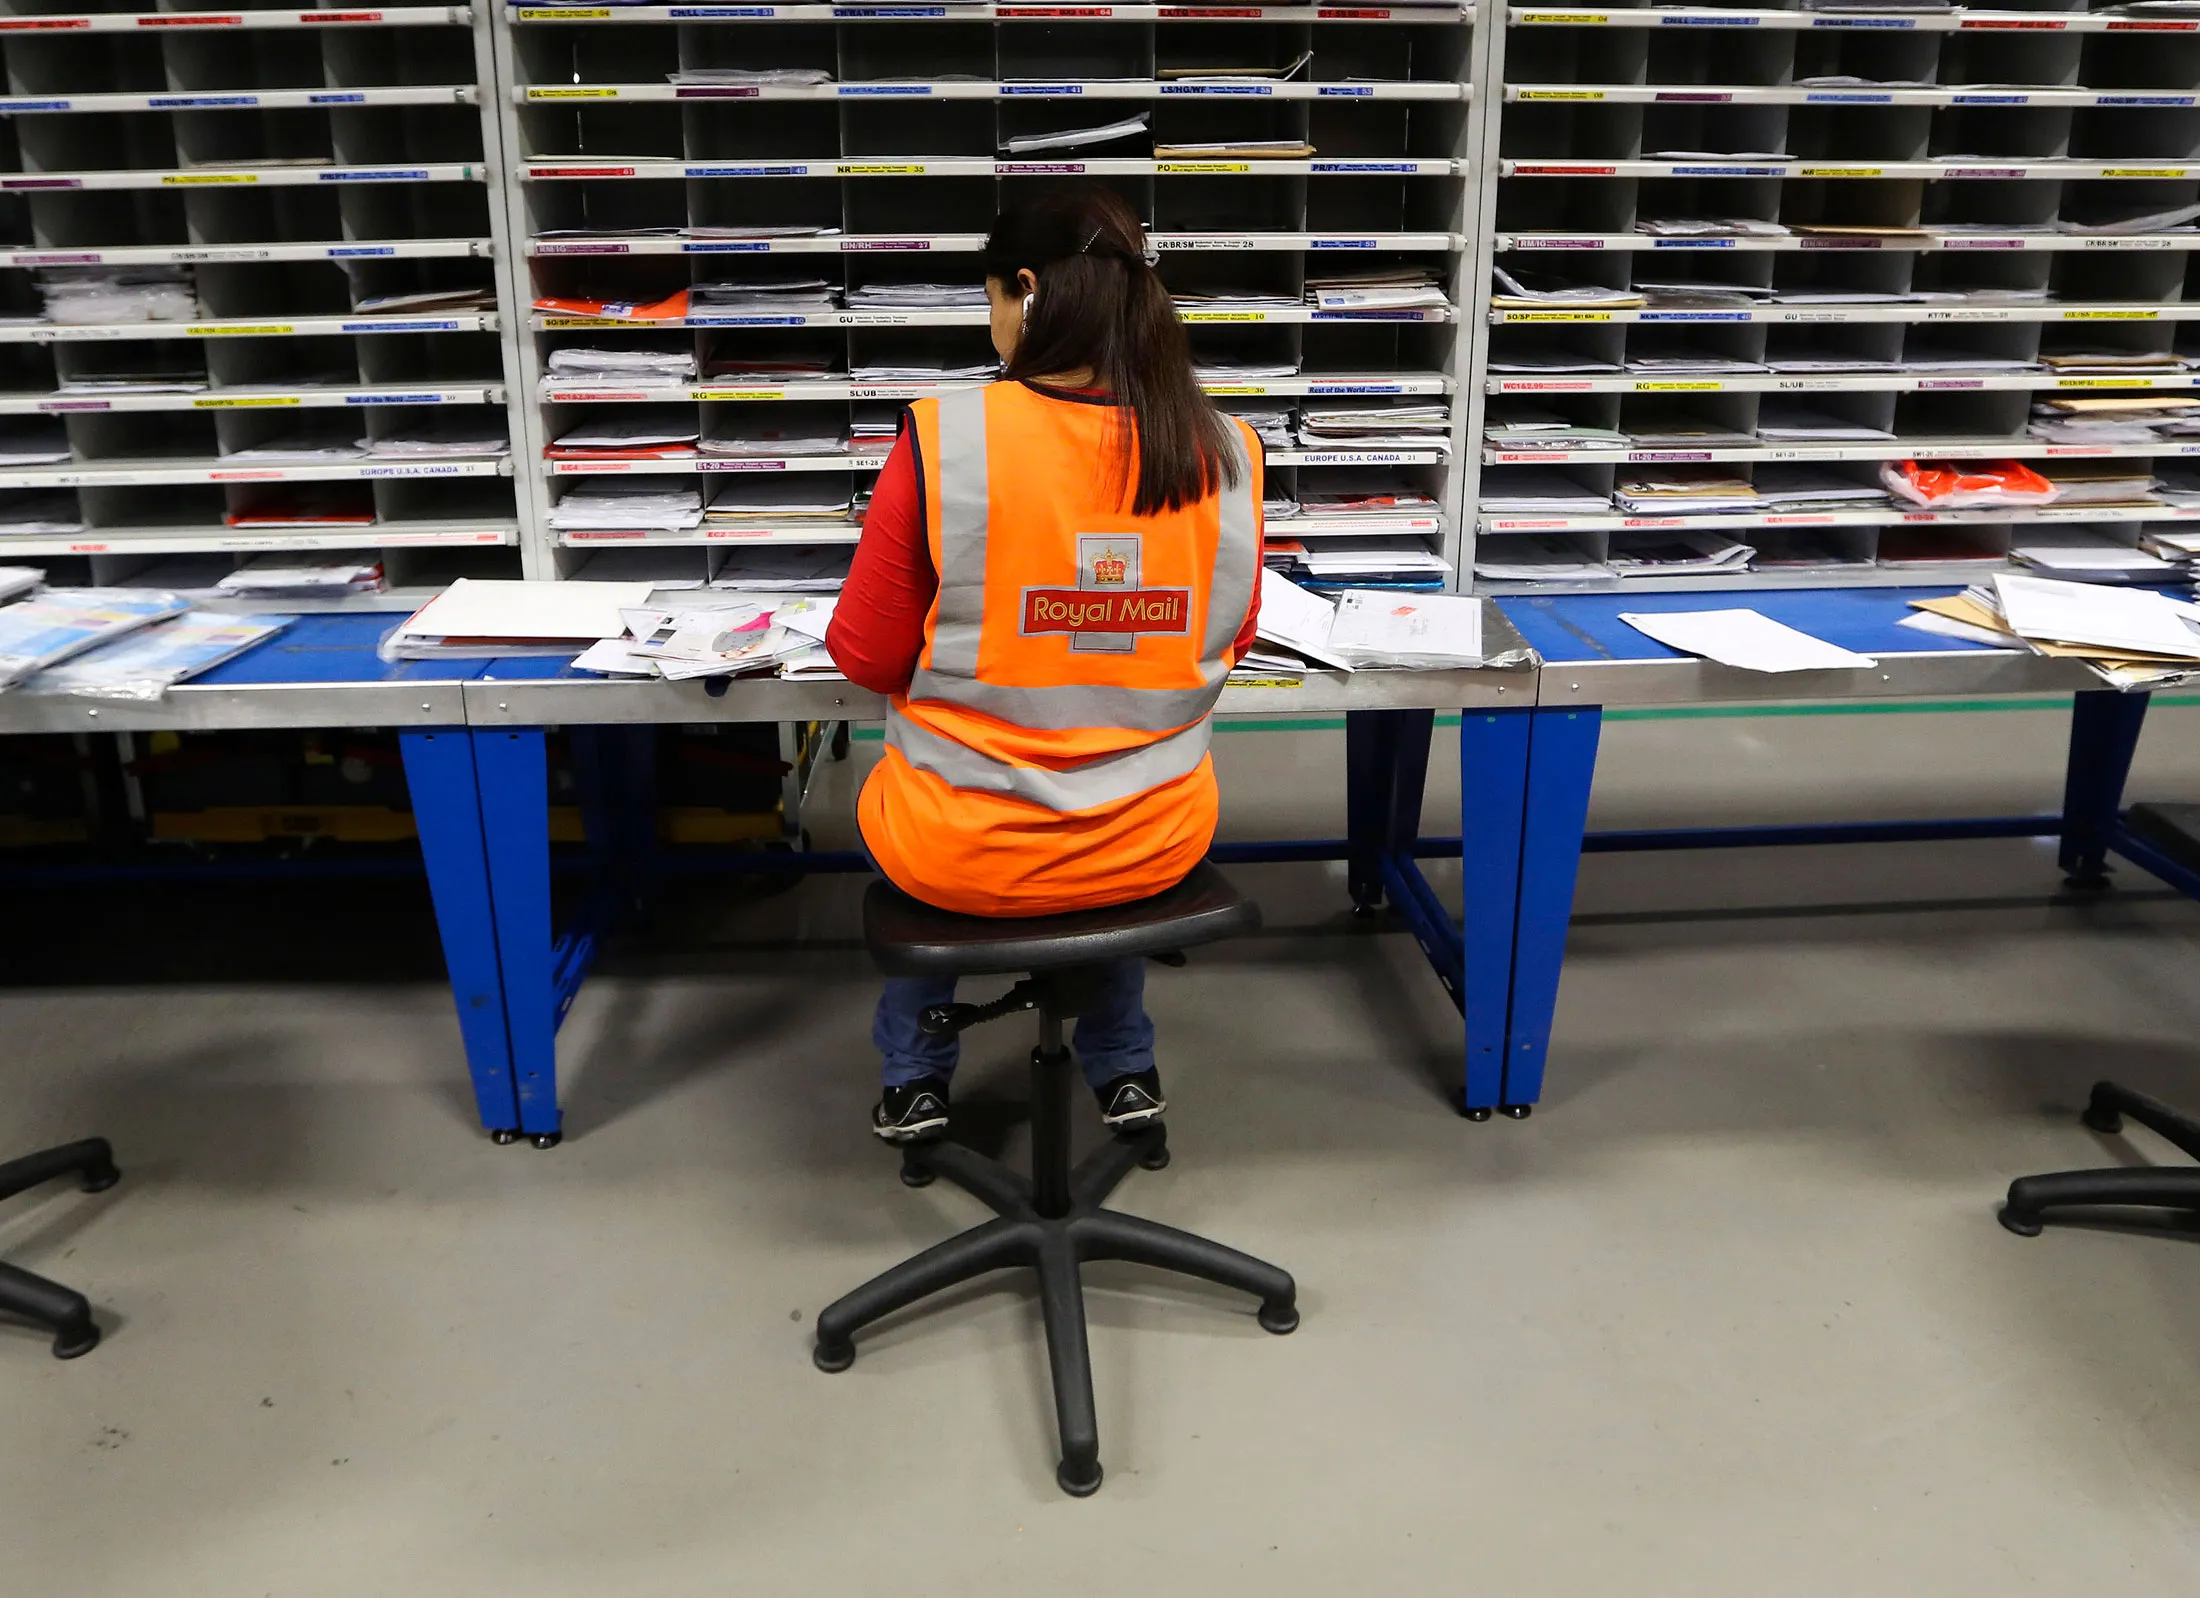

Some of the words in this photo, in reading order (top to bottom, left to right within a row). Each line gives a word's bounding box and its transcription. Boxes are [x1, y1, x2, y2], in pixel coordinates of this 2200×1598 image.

[1161, 86, 1206, 94] LS/HG/WF
[841, 242, 871, 250] BN/RH
[850, 390, 876, 398] SL/UB
[1304, 454, 1338, 462] EUROPE
[1341, 454, 1364, 462] U.S.A.
[697, 462, 720, 470] E1-20
[856, 459, 879, 467] SE1-28
[423, 466, 458, 474] CANADA
[1033, 596, 1113, 627] Royal
[1118, 596, 1180, 622] Mail
